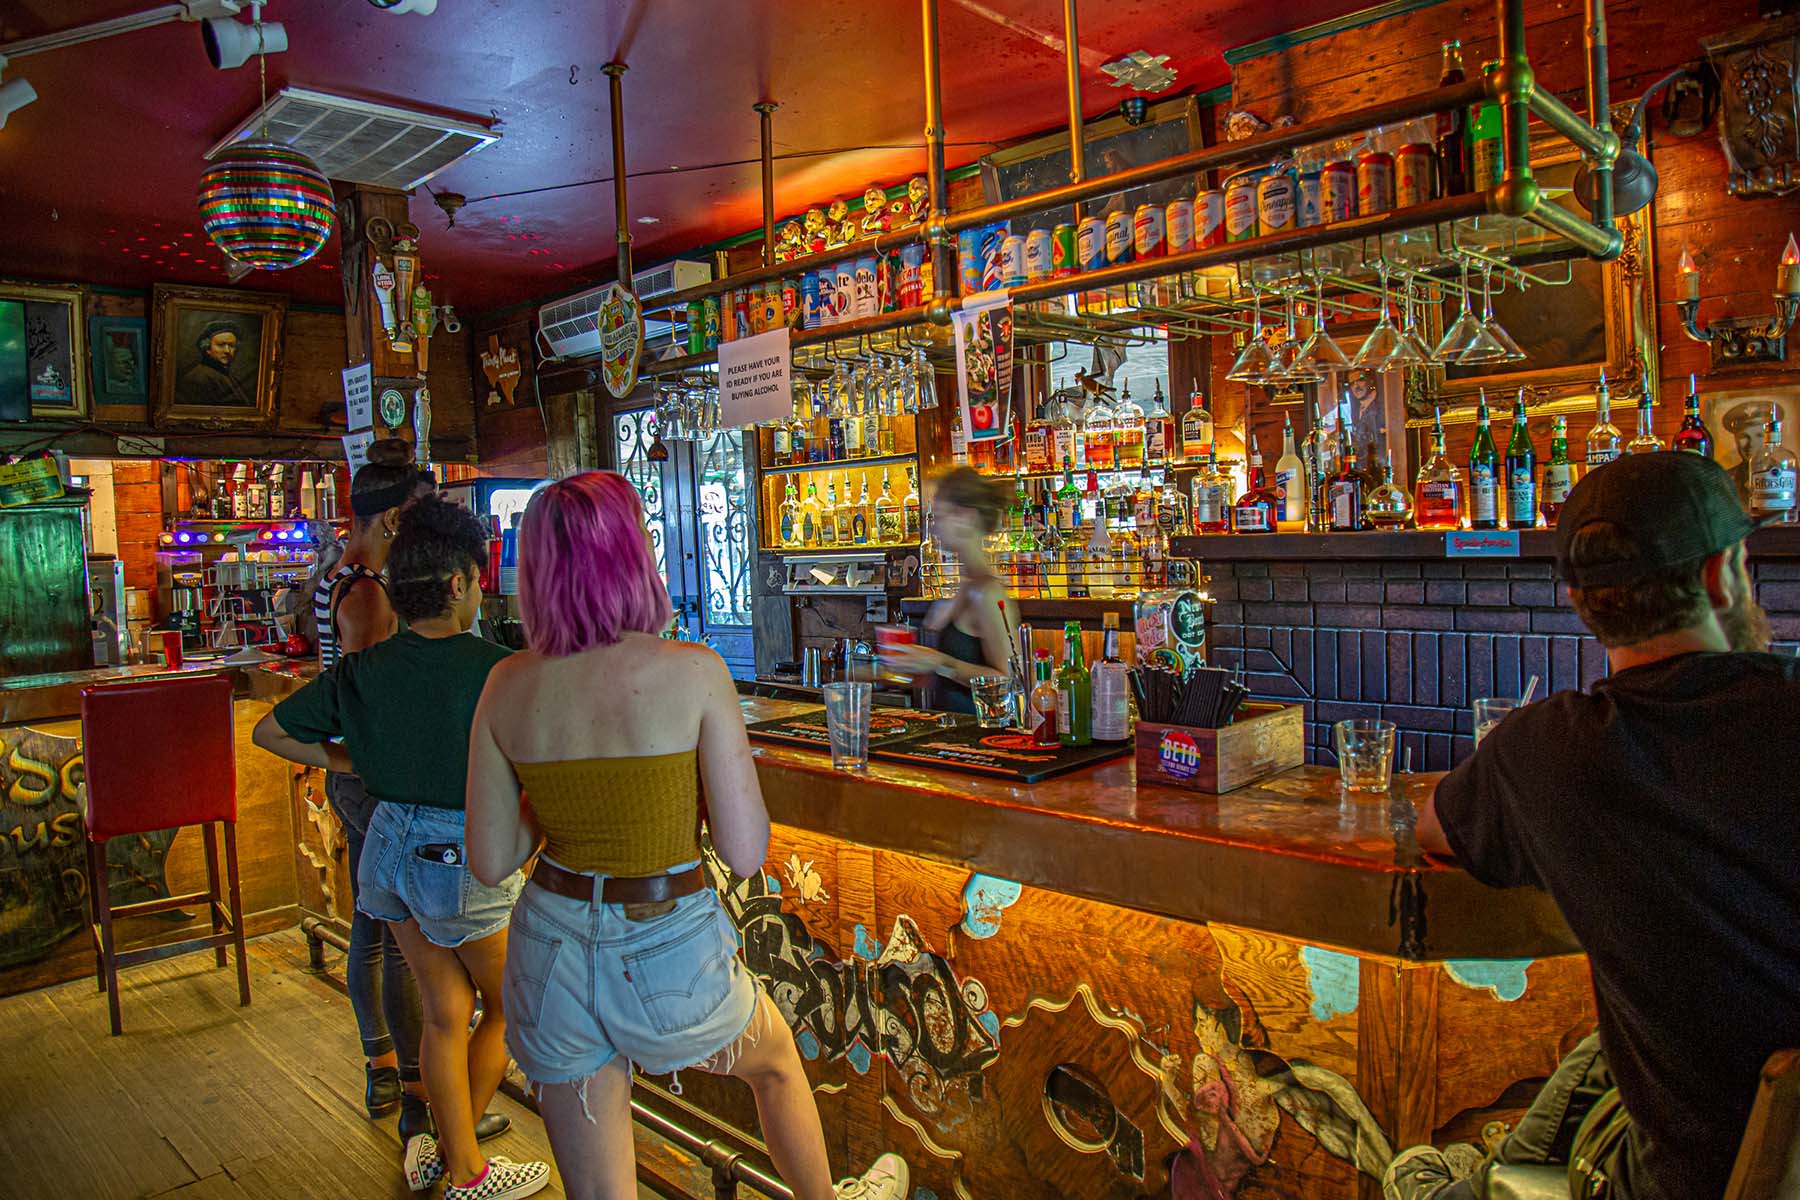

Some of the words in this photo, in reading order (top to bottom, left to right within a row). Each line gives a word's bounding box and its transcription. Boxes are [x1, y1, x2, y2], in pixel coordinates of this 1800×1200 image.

[727, 363, 748, 376] PLEASE
[748, 360, 763, 371] HAVE
[764, 355, 780, 367] YOUR
[733, 376, 753, 388] READY
[752, 374, 758, 383] IF
[758, 371, 771, 382] YOU
[771, 368, 783, 378] ARE
[731, 389, 753, 401] BUYING
[753, 383, 780, 395] ALCOHOL
[1164, 738, 1197, 767] BETO
